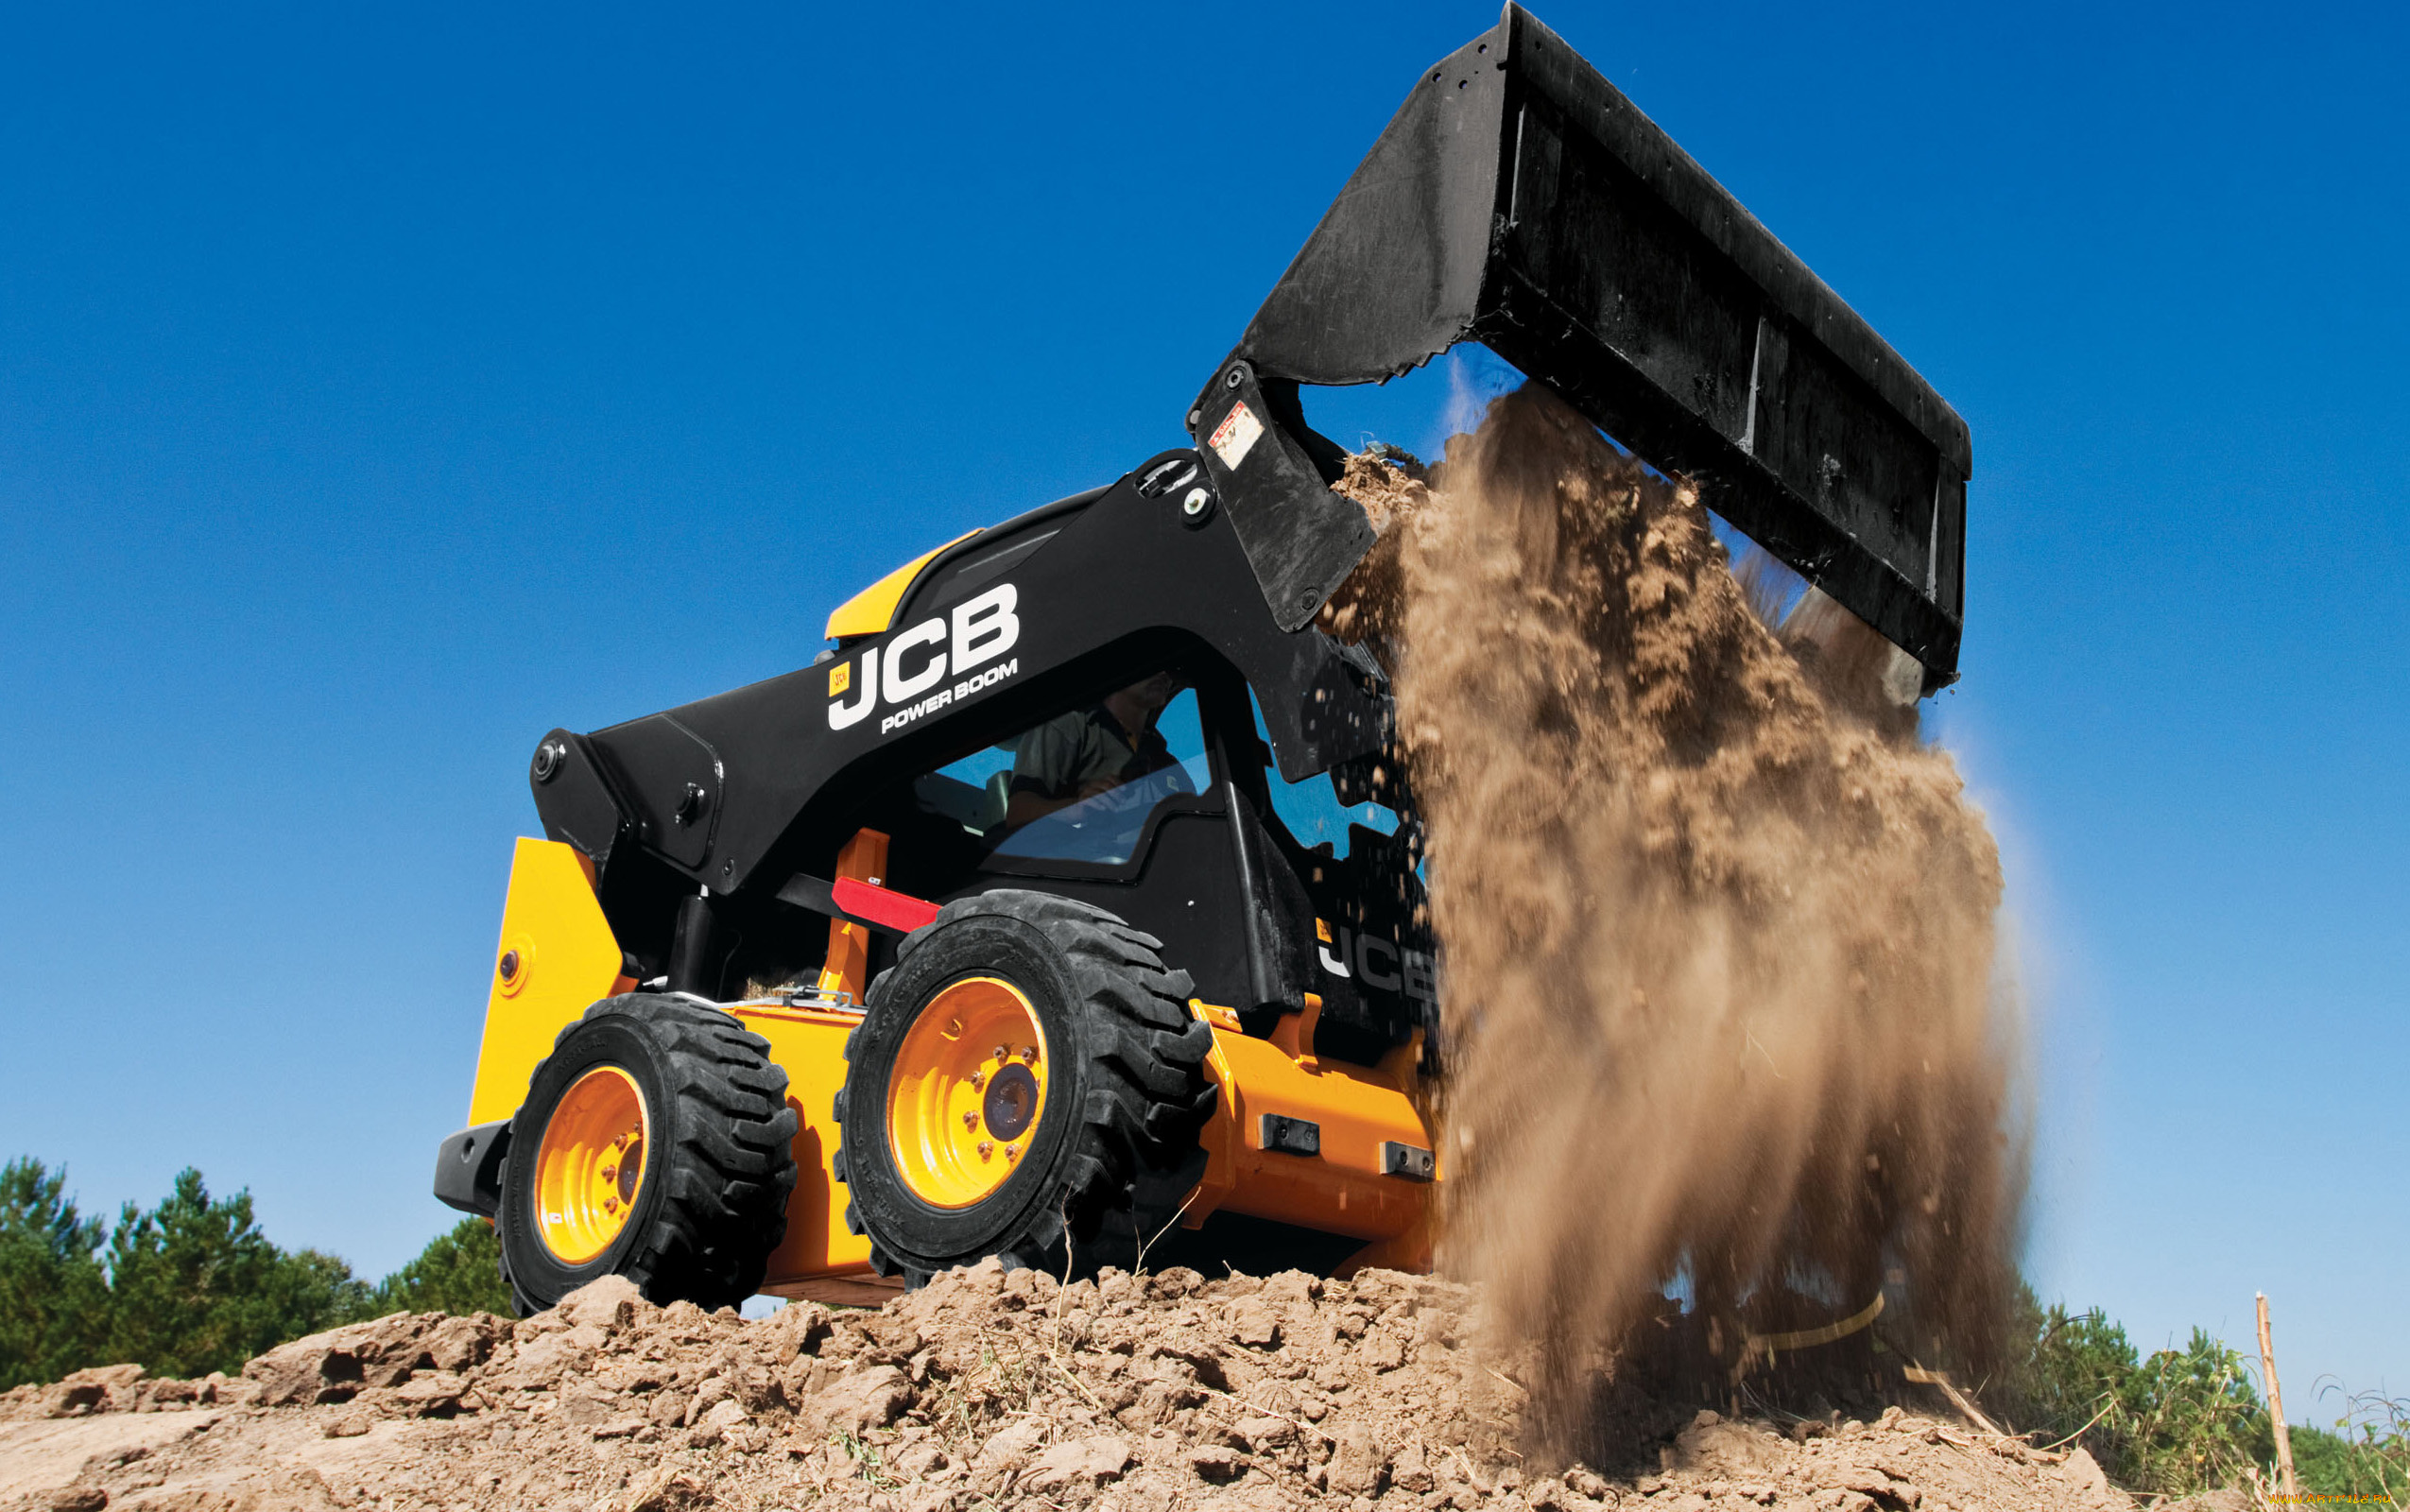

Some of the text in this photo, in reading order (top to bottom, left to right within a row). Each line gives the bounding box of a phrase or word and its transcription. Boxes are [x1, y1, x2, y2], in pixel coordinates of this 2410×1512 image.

[829, 583, 1020, 730] JCB
[882, 658, 1018, 734] POWER BOOM
[1318, 926, 1437, 1001] JCB
